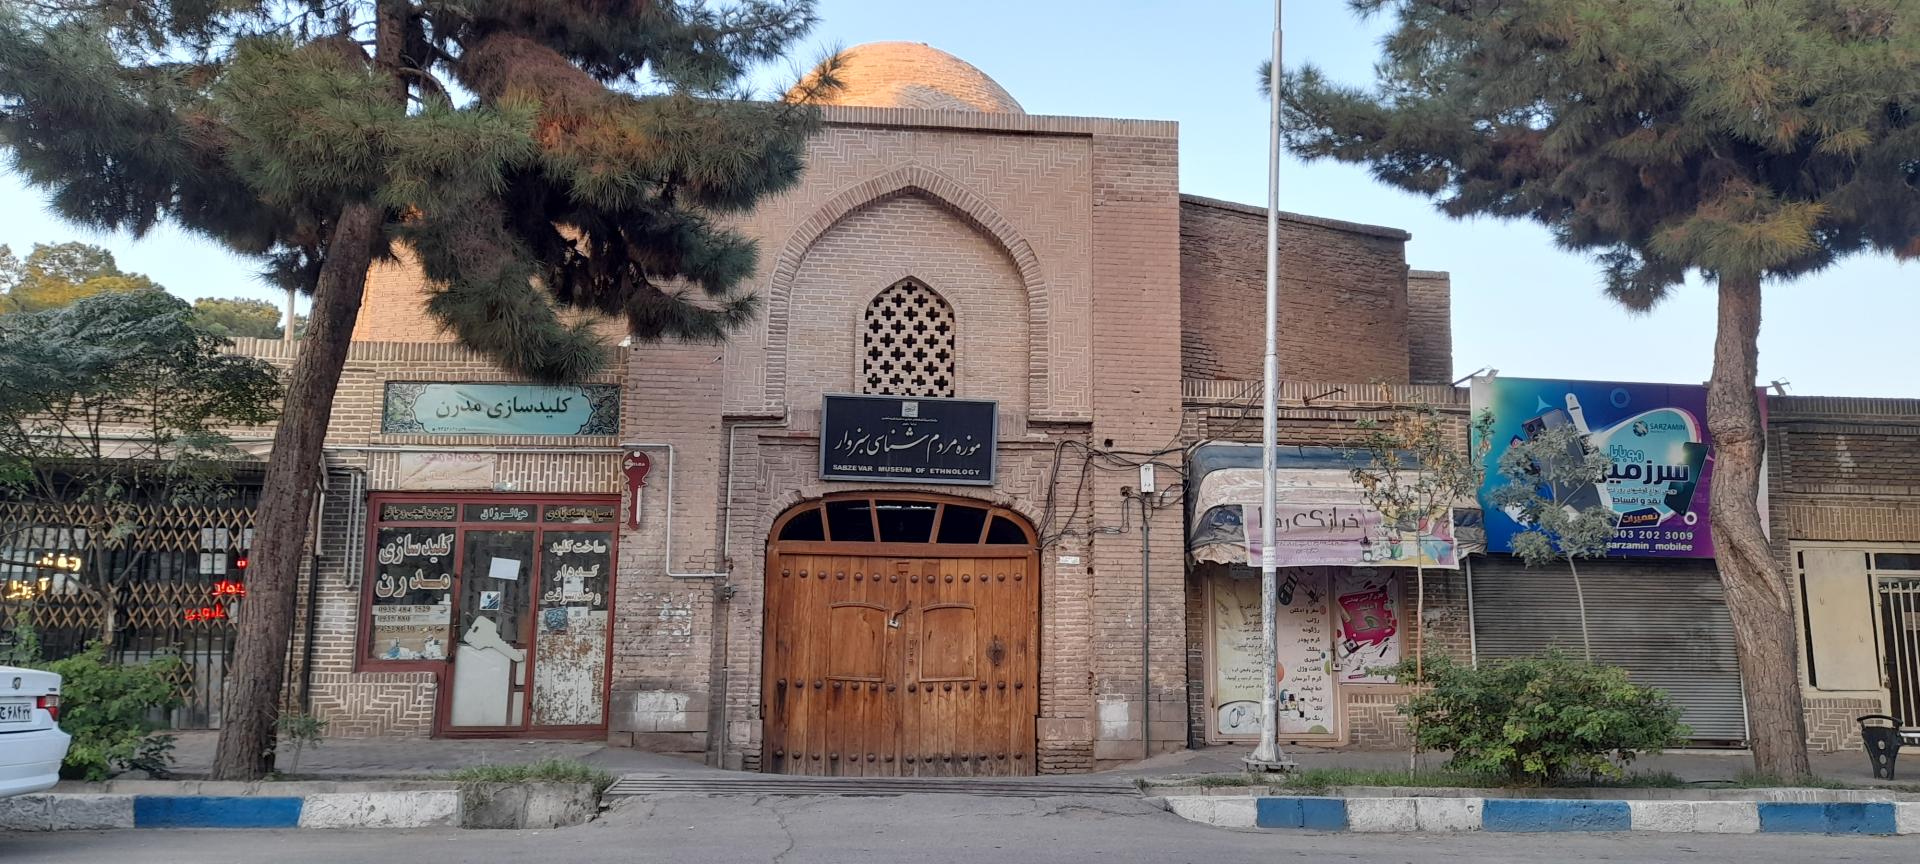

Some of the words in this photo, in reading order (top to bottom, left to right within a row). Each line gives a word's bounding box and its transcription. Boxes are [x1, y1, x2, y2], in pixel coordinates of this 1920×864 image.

[435, 398, 482, 418] مدرن
[1649, 422, 1686, 431] SARZAMIN
[834, 427, 871, 458] سبزوار
[866, 426, 931, 457] شناسی
[925, 433, 958, 464] مردم
[956, 434, 982, 457] موزه
[878, 466, 912, 474] MUSEUM
[929, 468, 981, 476] ETHNOLOGY
[1612, 496, 1639, 505] اقساط
[1622, 513, 1659, 524] تعمیرات
[1639, 530, 1661, 540] 202
[1664, 531, 1694, 541] 3009
[550, 540, 573, 557] کلید
[573, 540, 607, 554] ساخت
[1605, 540, 1693, 553] sarzamin_mobilee
[374, 567, 451, 599] مدرن
